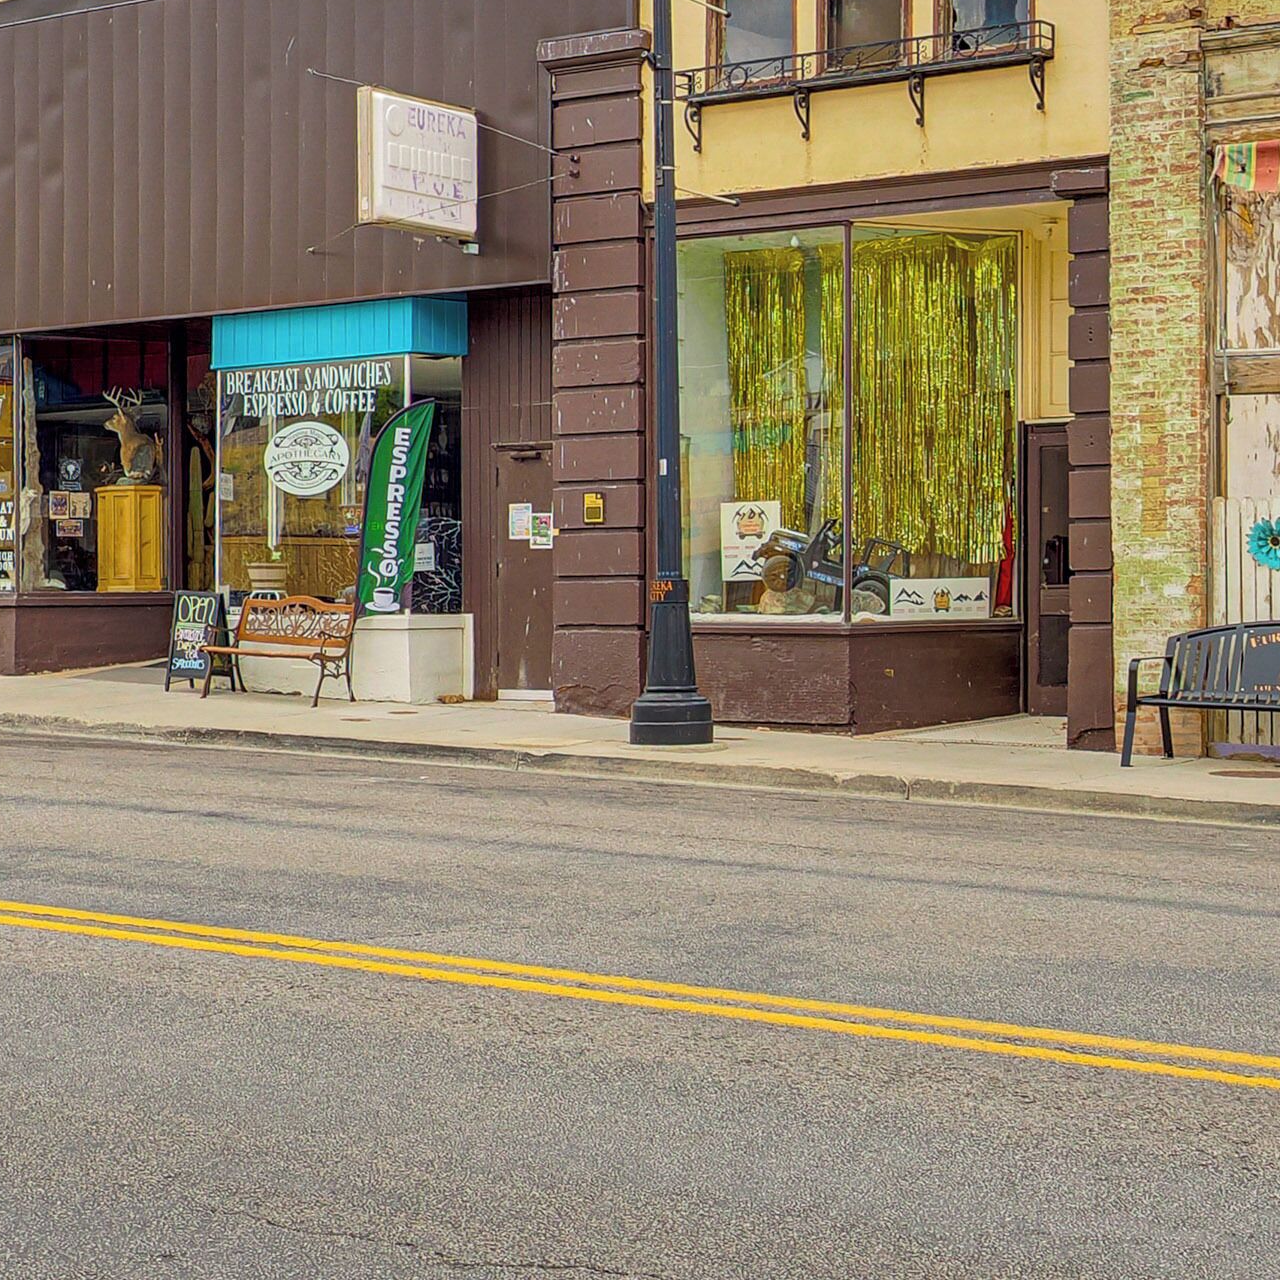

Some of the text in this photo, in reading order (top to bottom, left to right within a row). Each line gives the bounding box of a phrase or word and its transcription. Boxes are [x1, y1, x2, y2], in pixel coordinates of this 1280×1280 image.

[407, 107, 466, 140] EUREKA
[226, 360, 392, 396] BREAKFAST SANDWICHES
[243, 388, 376, 418] ESPRESSO & COFFEE
[271, 448, 342, 463] APOTHECARY
[379, 427, 412, 578] ESPRESSO
